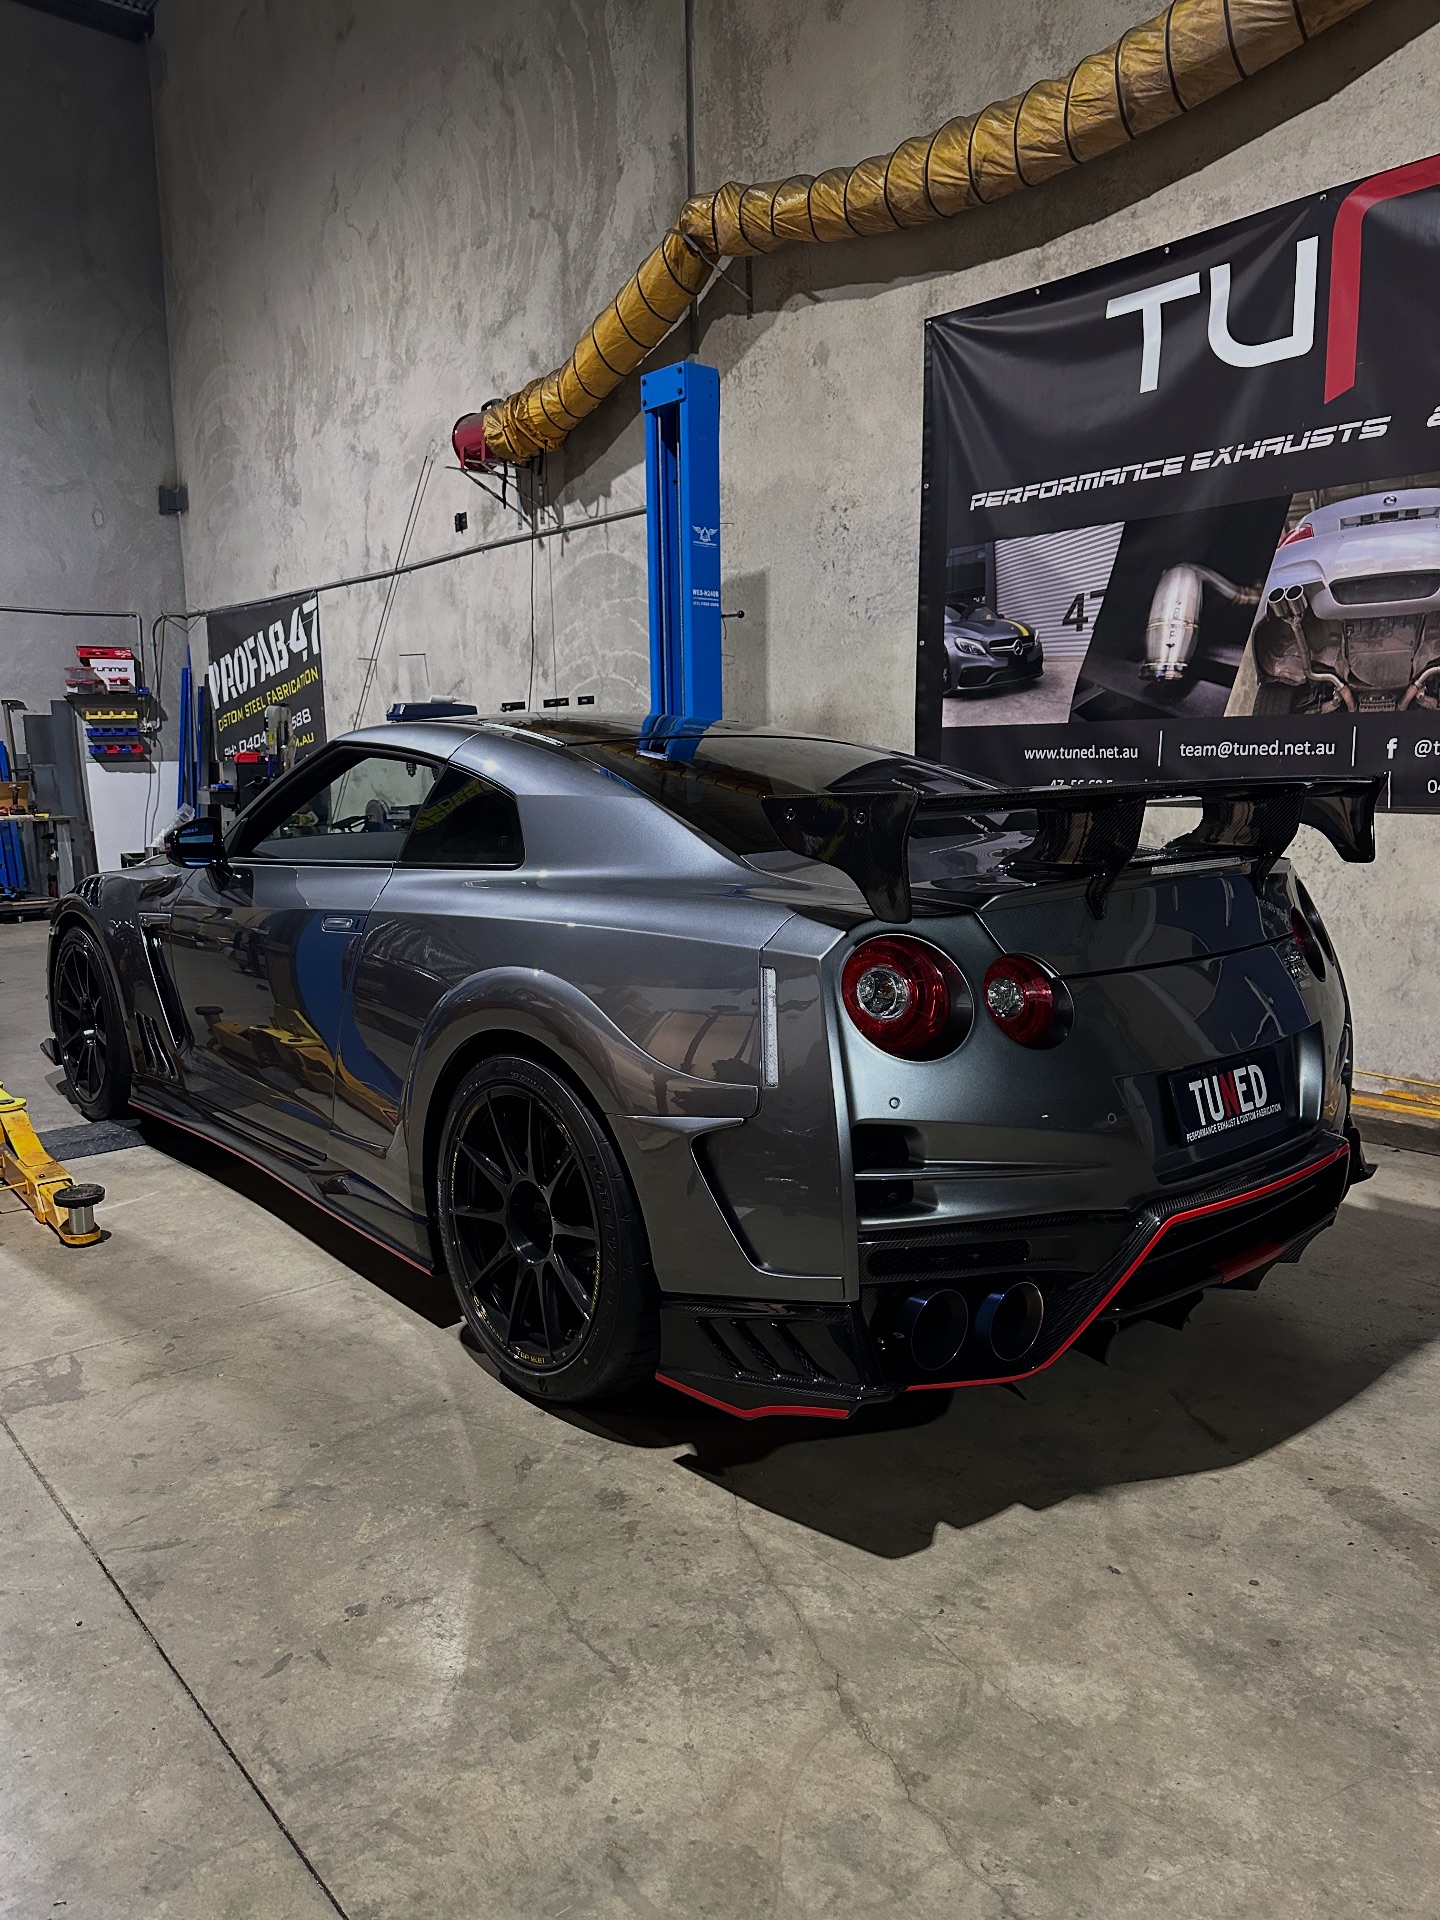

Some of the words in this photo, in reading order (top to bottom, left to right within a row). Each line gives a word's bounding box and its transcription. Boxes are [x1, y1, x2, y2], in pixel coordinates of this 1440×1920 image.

[969, 455, 1186, 512] PERFORMANCE
[1189, 415, 1392, 472] EXHAUSTS
[208, 597, 320, 709] PROFAB47
[244, 695, 267, 718] STEEL
[266, 665, 319, 706] FABRICATION
[1024, 745, 1139, 760] www.tuned.net.au
[1179, 739, 1335, 759] team@tuned.net.au
[1186, 1123, 1218, 1143] PERFORMANCE
[1217, 1117, 1236, 1132] EXHAUST
[1240, 1111, 1257, 1124] CUSTOM
[1255, 1103, 1282, 1118] FABRICATION
[1188, 1064, 1268, 1126] TUNED
